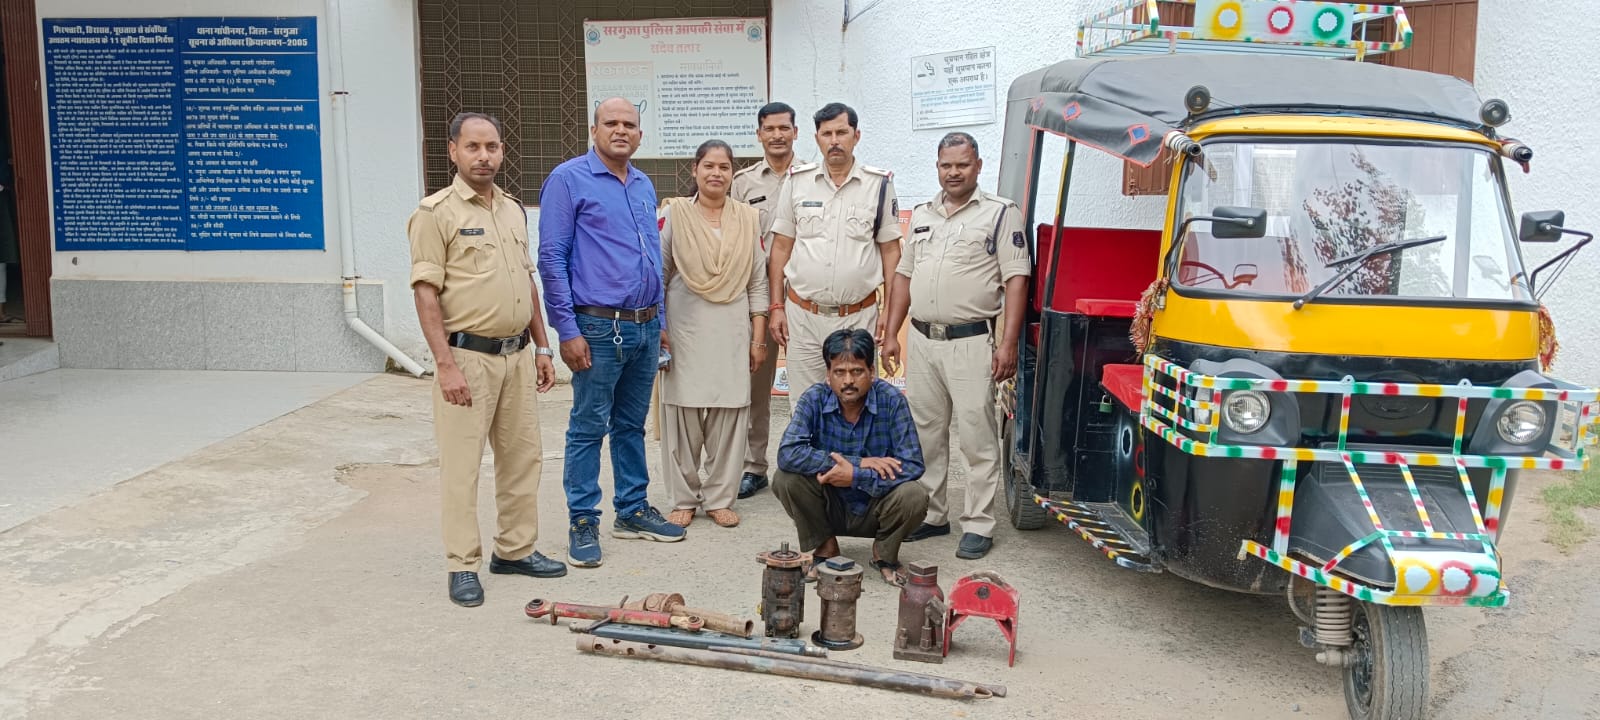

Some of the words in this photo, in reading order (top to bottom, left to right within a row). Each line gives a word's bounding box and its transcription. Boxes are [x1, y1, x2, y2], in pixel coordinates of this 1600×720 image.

[197, 27, 214, 35] थाना
[273, 27, 299, 38] सरगुजा
[603, 25, 641, 39] सरगुजा
[643, 22, 673, 38] पुलिस
[675, 22, 712, 36] आपकी
[713, 21, 734, 35] सेवा
[736, 20, 746, 33] में
[188, 38, 209, 48] सूचना
[217, 37, 245, 46] अधिकार
[651, 41, 674, 54] सदैव
